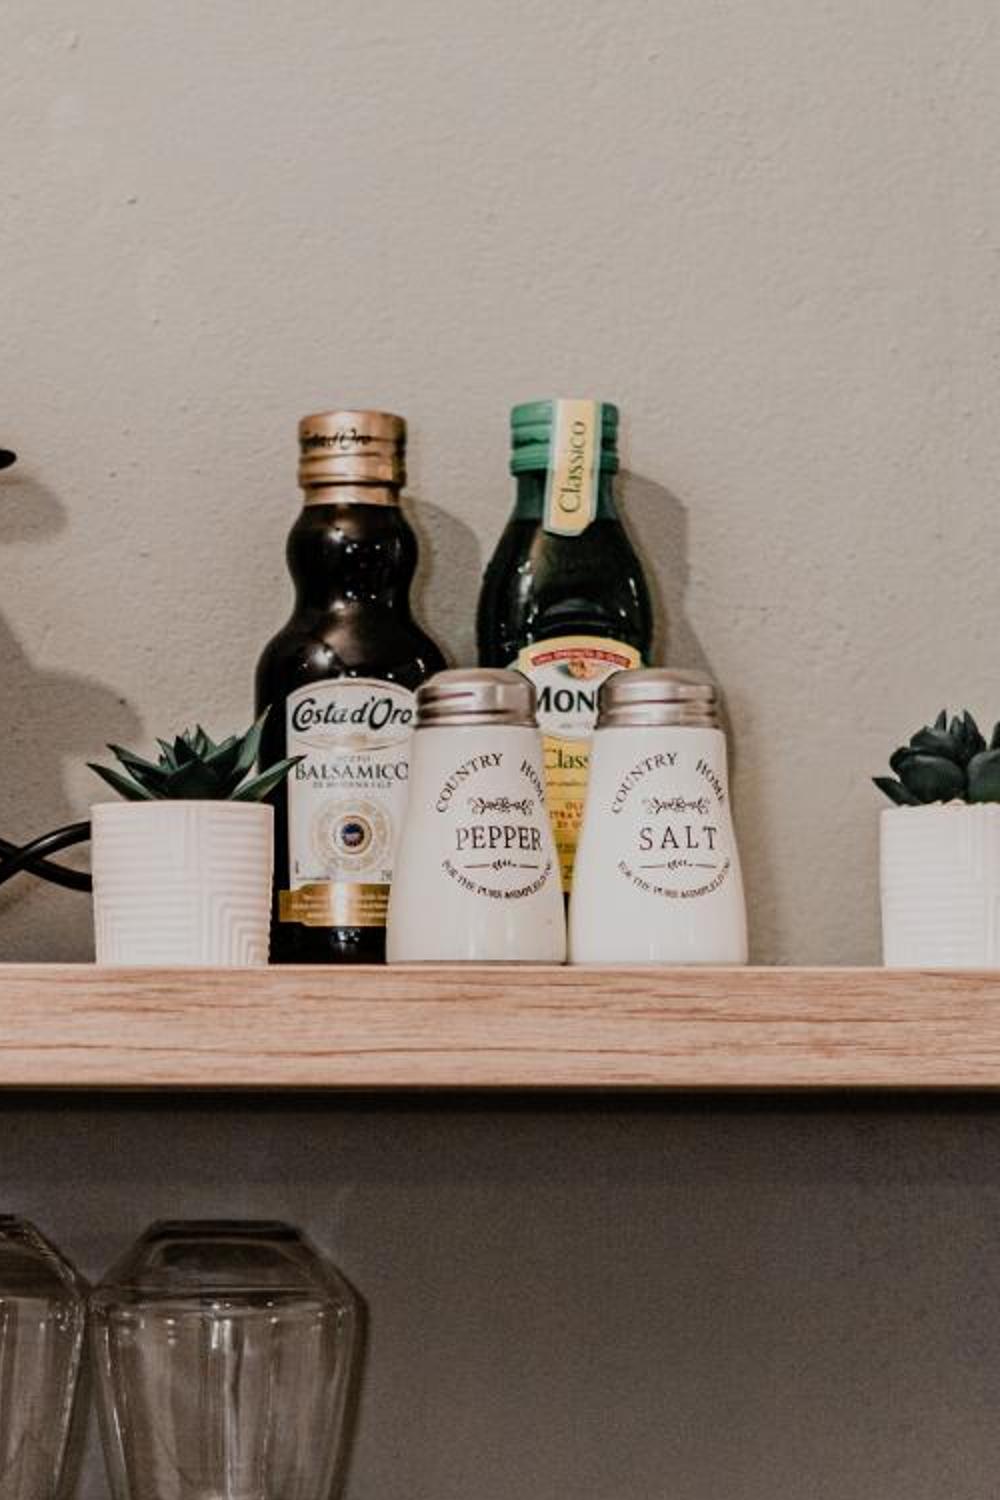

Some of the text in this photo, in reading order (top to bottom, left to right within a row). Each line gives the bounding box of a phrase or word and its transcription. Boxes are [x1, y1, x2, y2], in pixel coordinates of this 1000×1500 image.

[558, 420, 585, 513] Classico
[292, 696, 413, 732] Costa d'Oro
[296, 762, 408, 780] BALSAMICO
[436, 753, 503, 813] COUNTRY
[611, 752, 677, 814] COUNTRY
[455, 825, 542, 851] PEPPER
[639, 825, 717, 851] SALT
